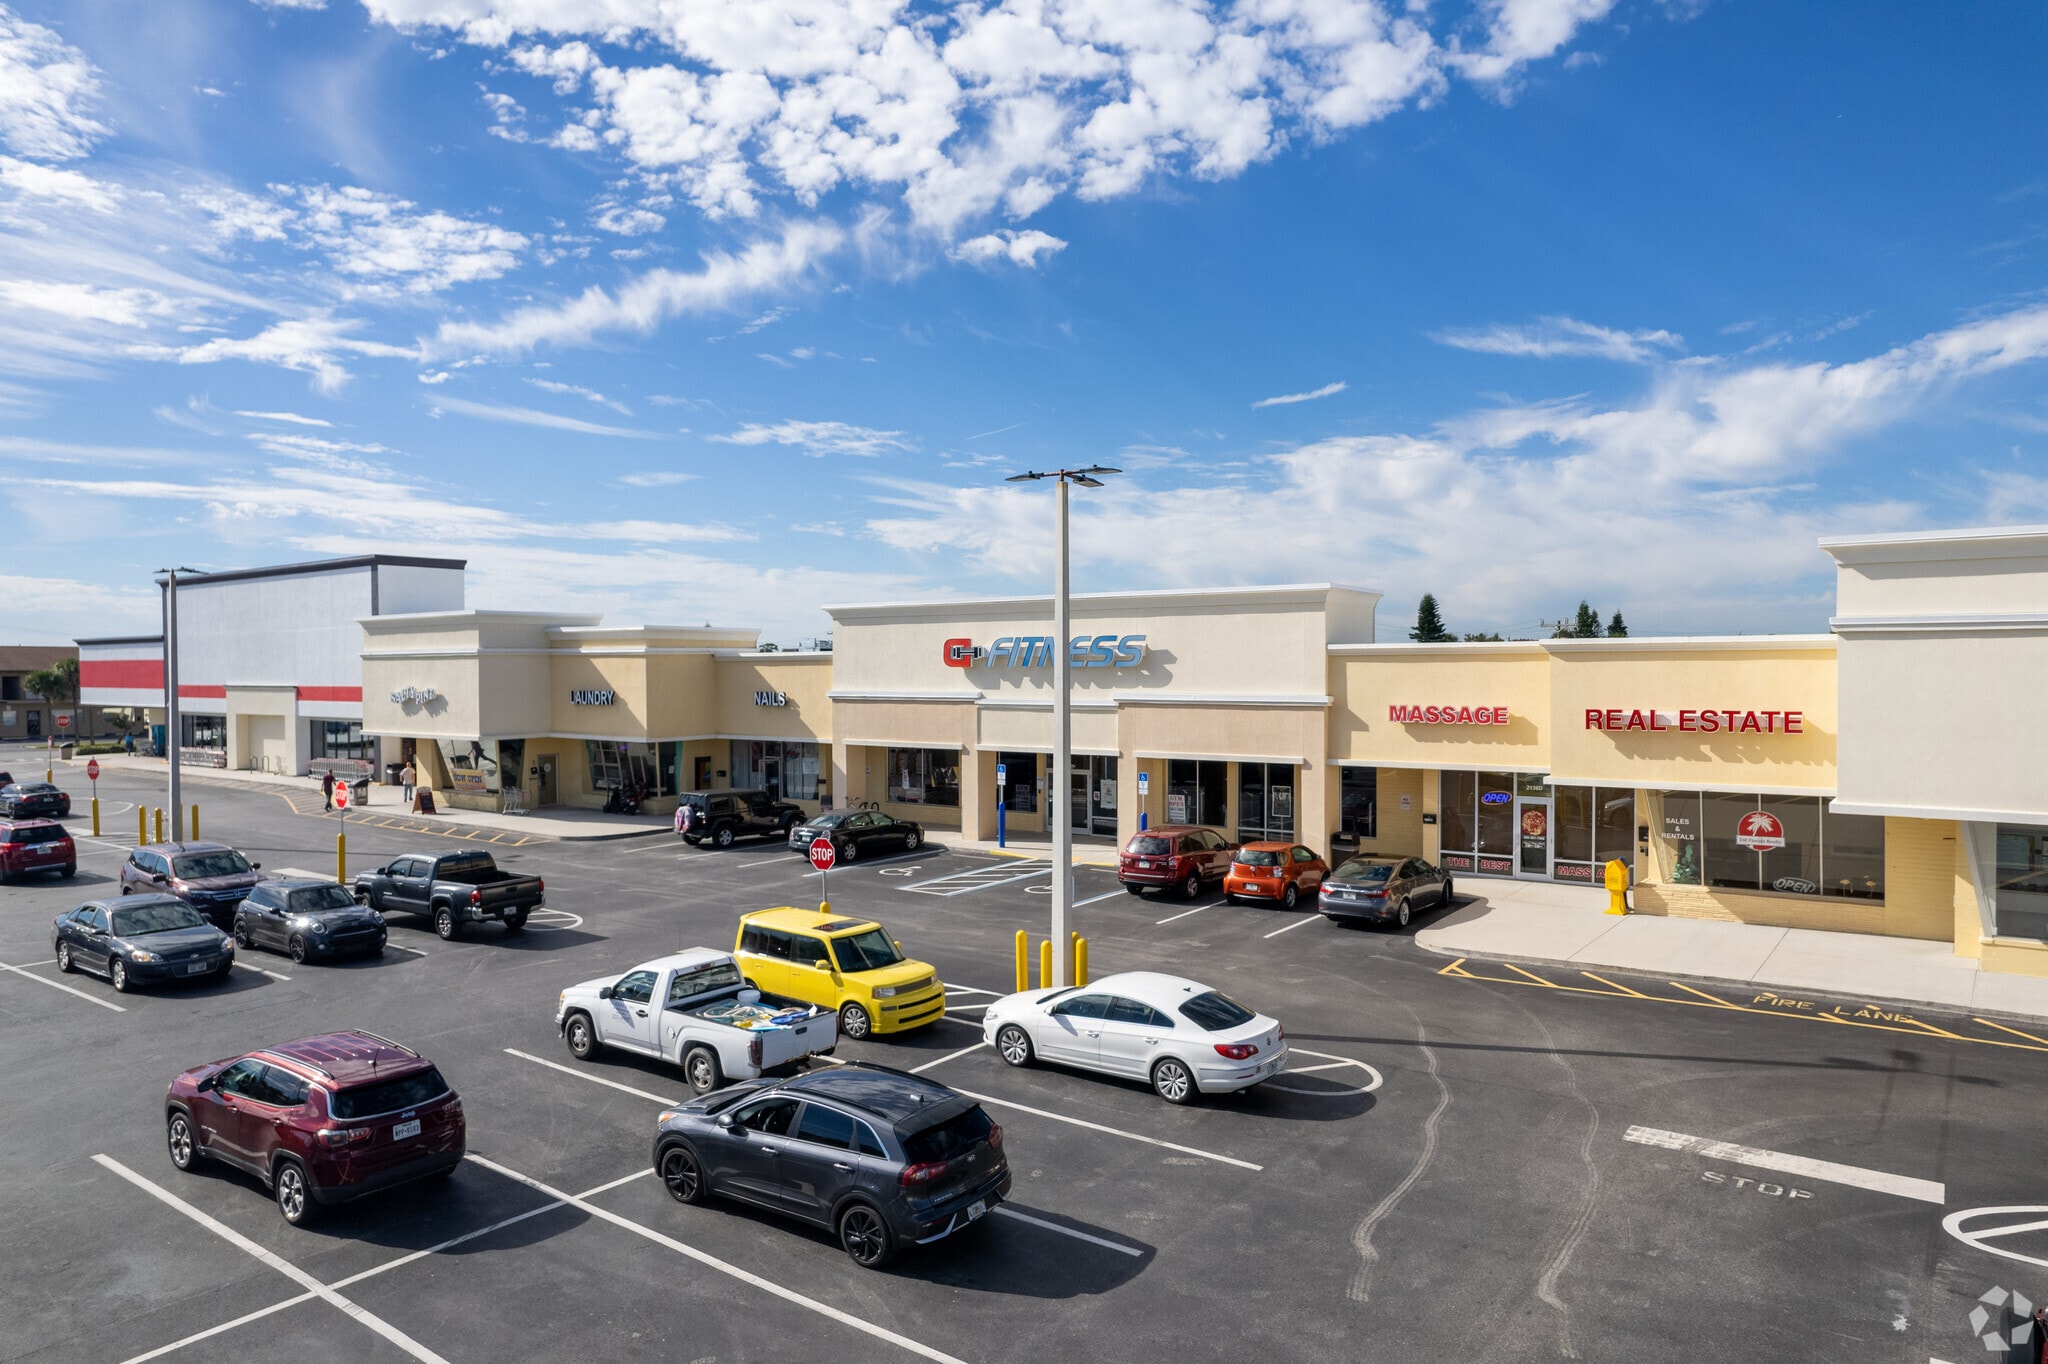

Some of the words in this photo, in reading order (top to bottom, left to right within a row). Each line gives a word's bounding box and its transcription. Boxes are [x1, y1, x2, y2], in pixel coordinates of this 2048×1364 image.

[570, 690, 615, 705] LAUNDRY
[754, 691, 787, 706] NAILS
[1389, 705, 1510, 726] MASSAGE
[1585, 708, 1668, 732] REAL
[1678, 709, 1804, 734] ESTATE
[88, 765, 99, 774] STOP
[468, 775, 482, 783] OPEN
[336, 789, 347, 801] STOP
[1483, 793, 1509, 804] OPEN
[1665, 817, 1690, 825] SALES
[1661, 832, 1695, 841] RENTALS
[812, 847, 833, 861] STOP
[1447, 856, 1470, 868] THE
[1481, 860, 1511, 871] BEST
[1558, 865, 1606, 878] MASSA
[1776, 878, 1812, 894] OPEN
[1752, 994, 1815, 1011] FIRE
[1833, 1005, 1913, 1023] LANE
[400, 1110, 416, 1119] Jeep
[1701, 1171, 1816, 1199] STOP
